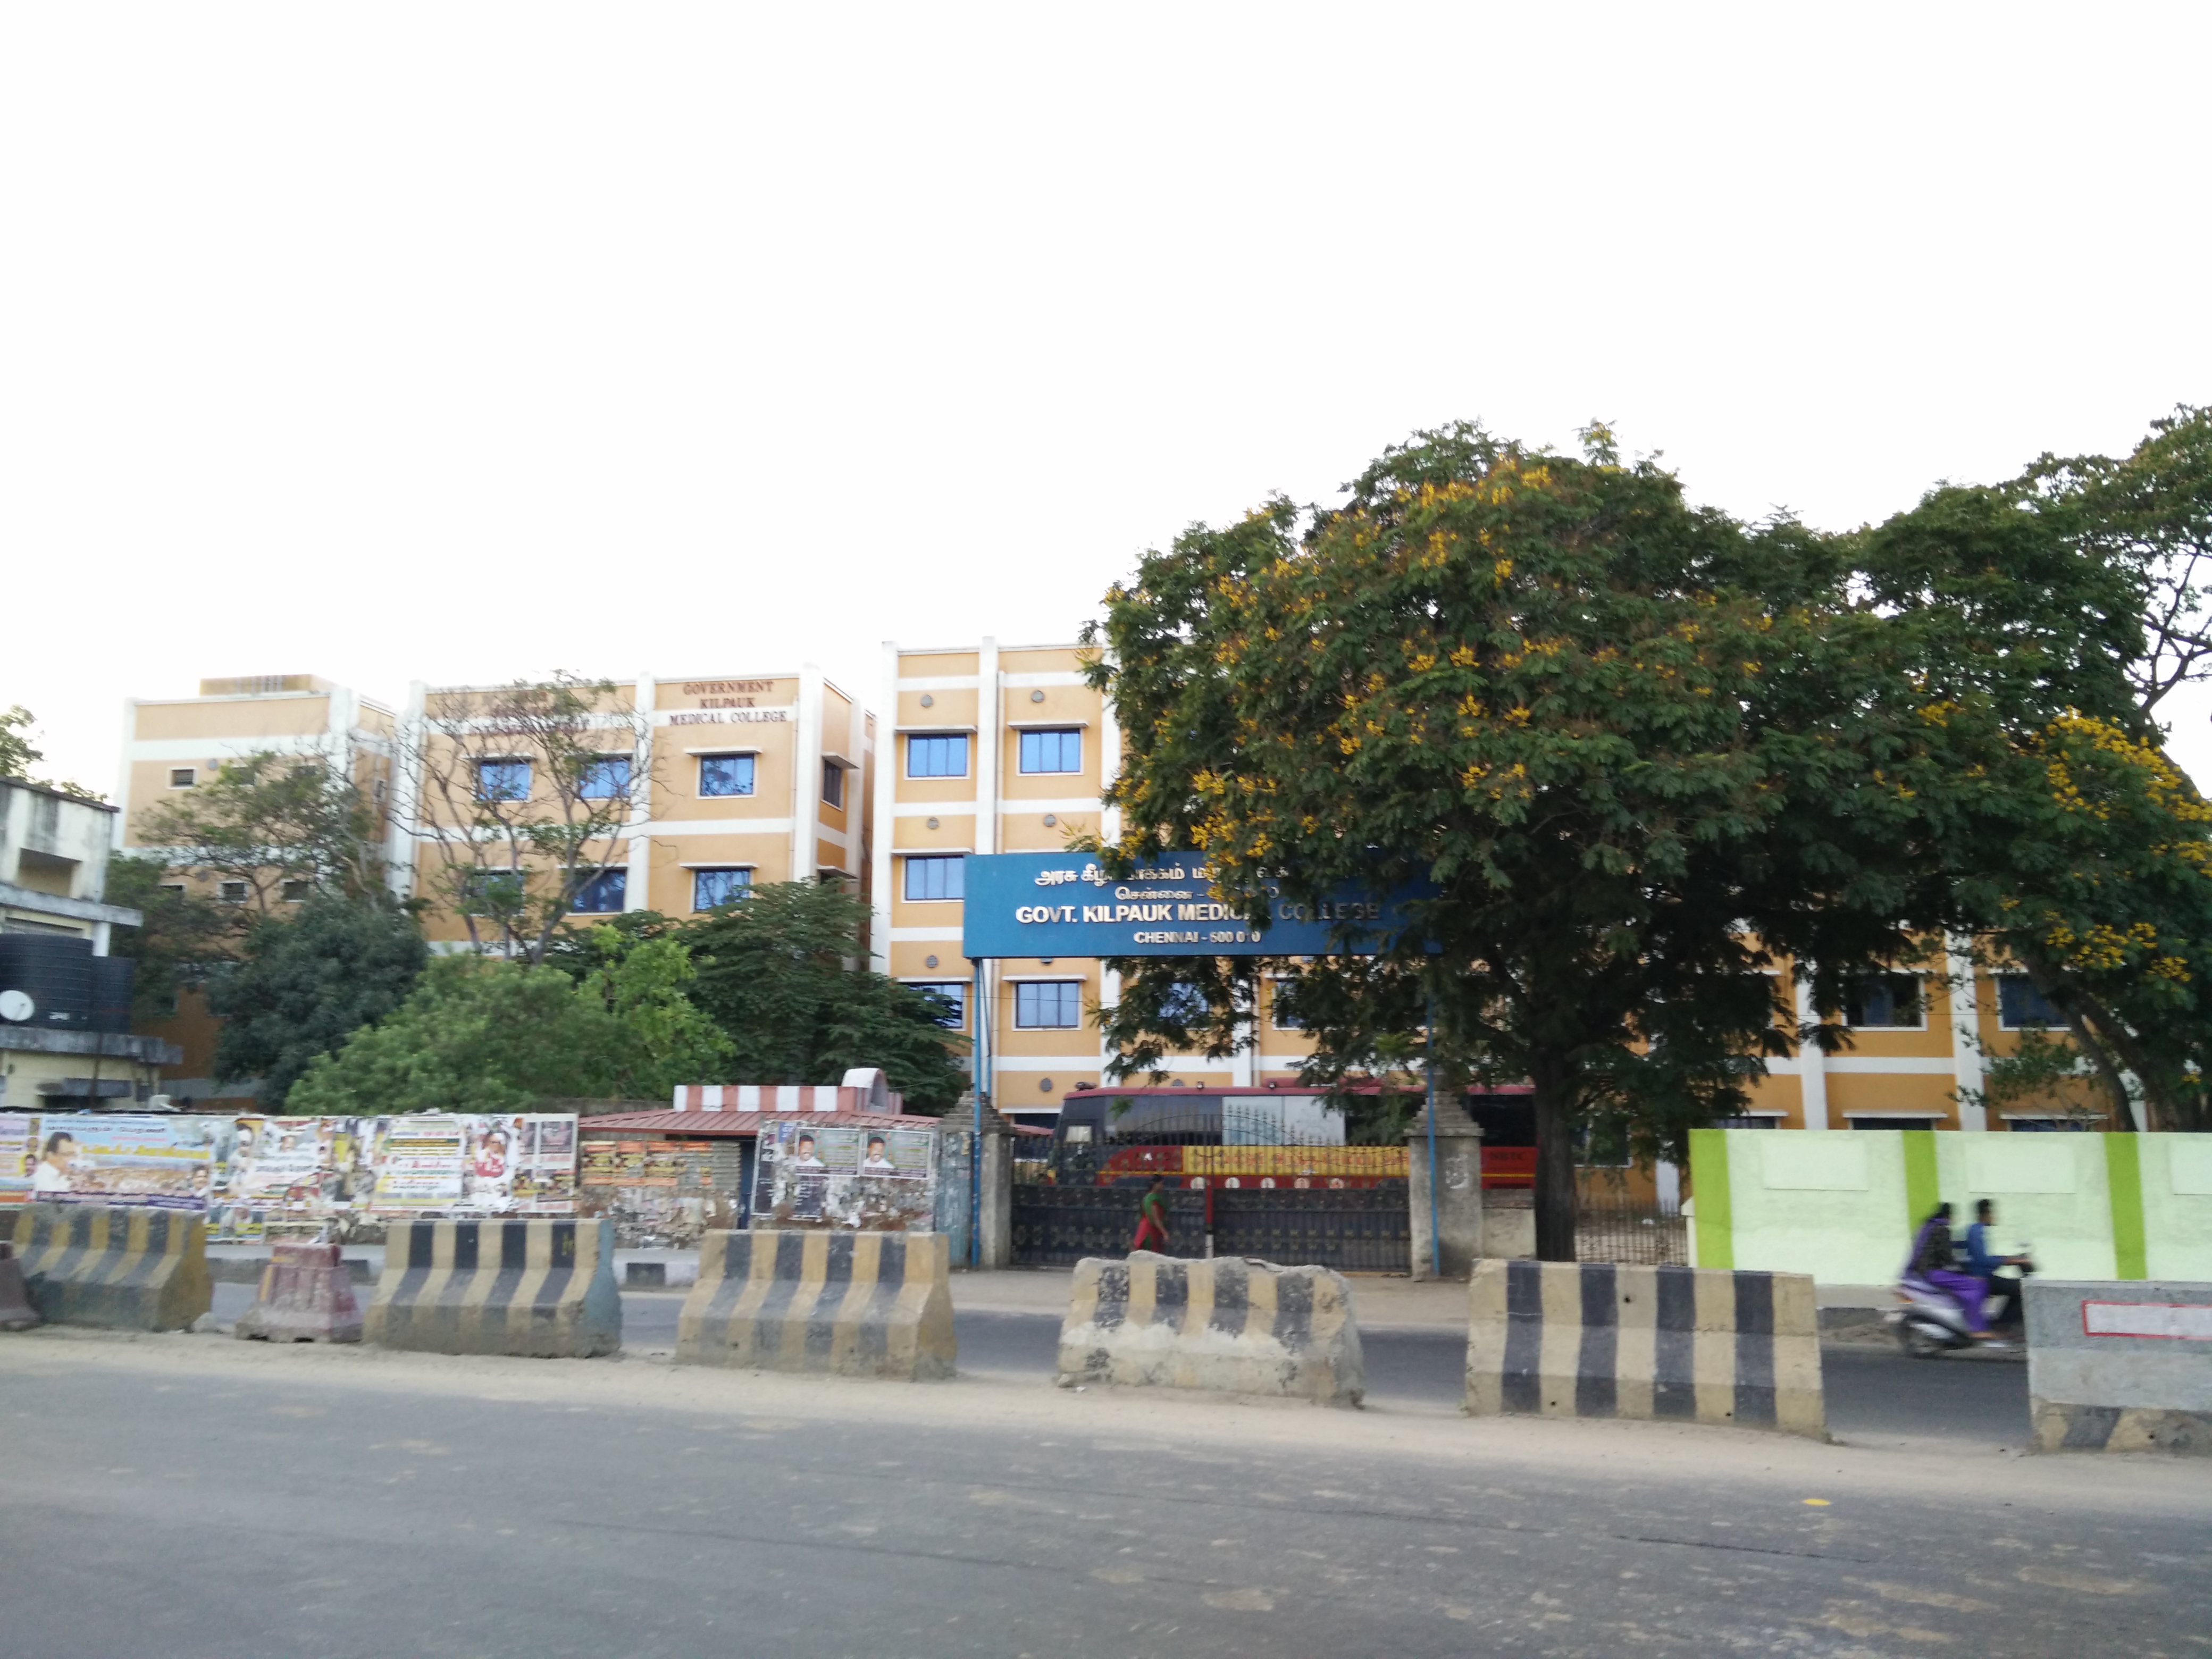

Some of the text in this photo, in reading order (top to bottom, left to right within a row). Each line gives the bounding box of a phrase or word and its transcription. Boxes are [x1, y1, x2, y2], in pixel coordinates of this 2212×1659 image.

[683, 681, 773, 695] GOVERNMENT
[700, 698, 755, 709] KILPAUK
[670, 711, 786, 725] MEDICAL COLLEGE
[1016, 906, 1078, 923] GOVT.
[1083, 904, 1173, 923] KILPAUK
[1178, 903, 1271, 921] MEDIC
[1133, 932, 1199, 943] CHENNAI
[1210, 931, 1234, 943] 600
